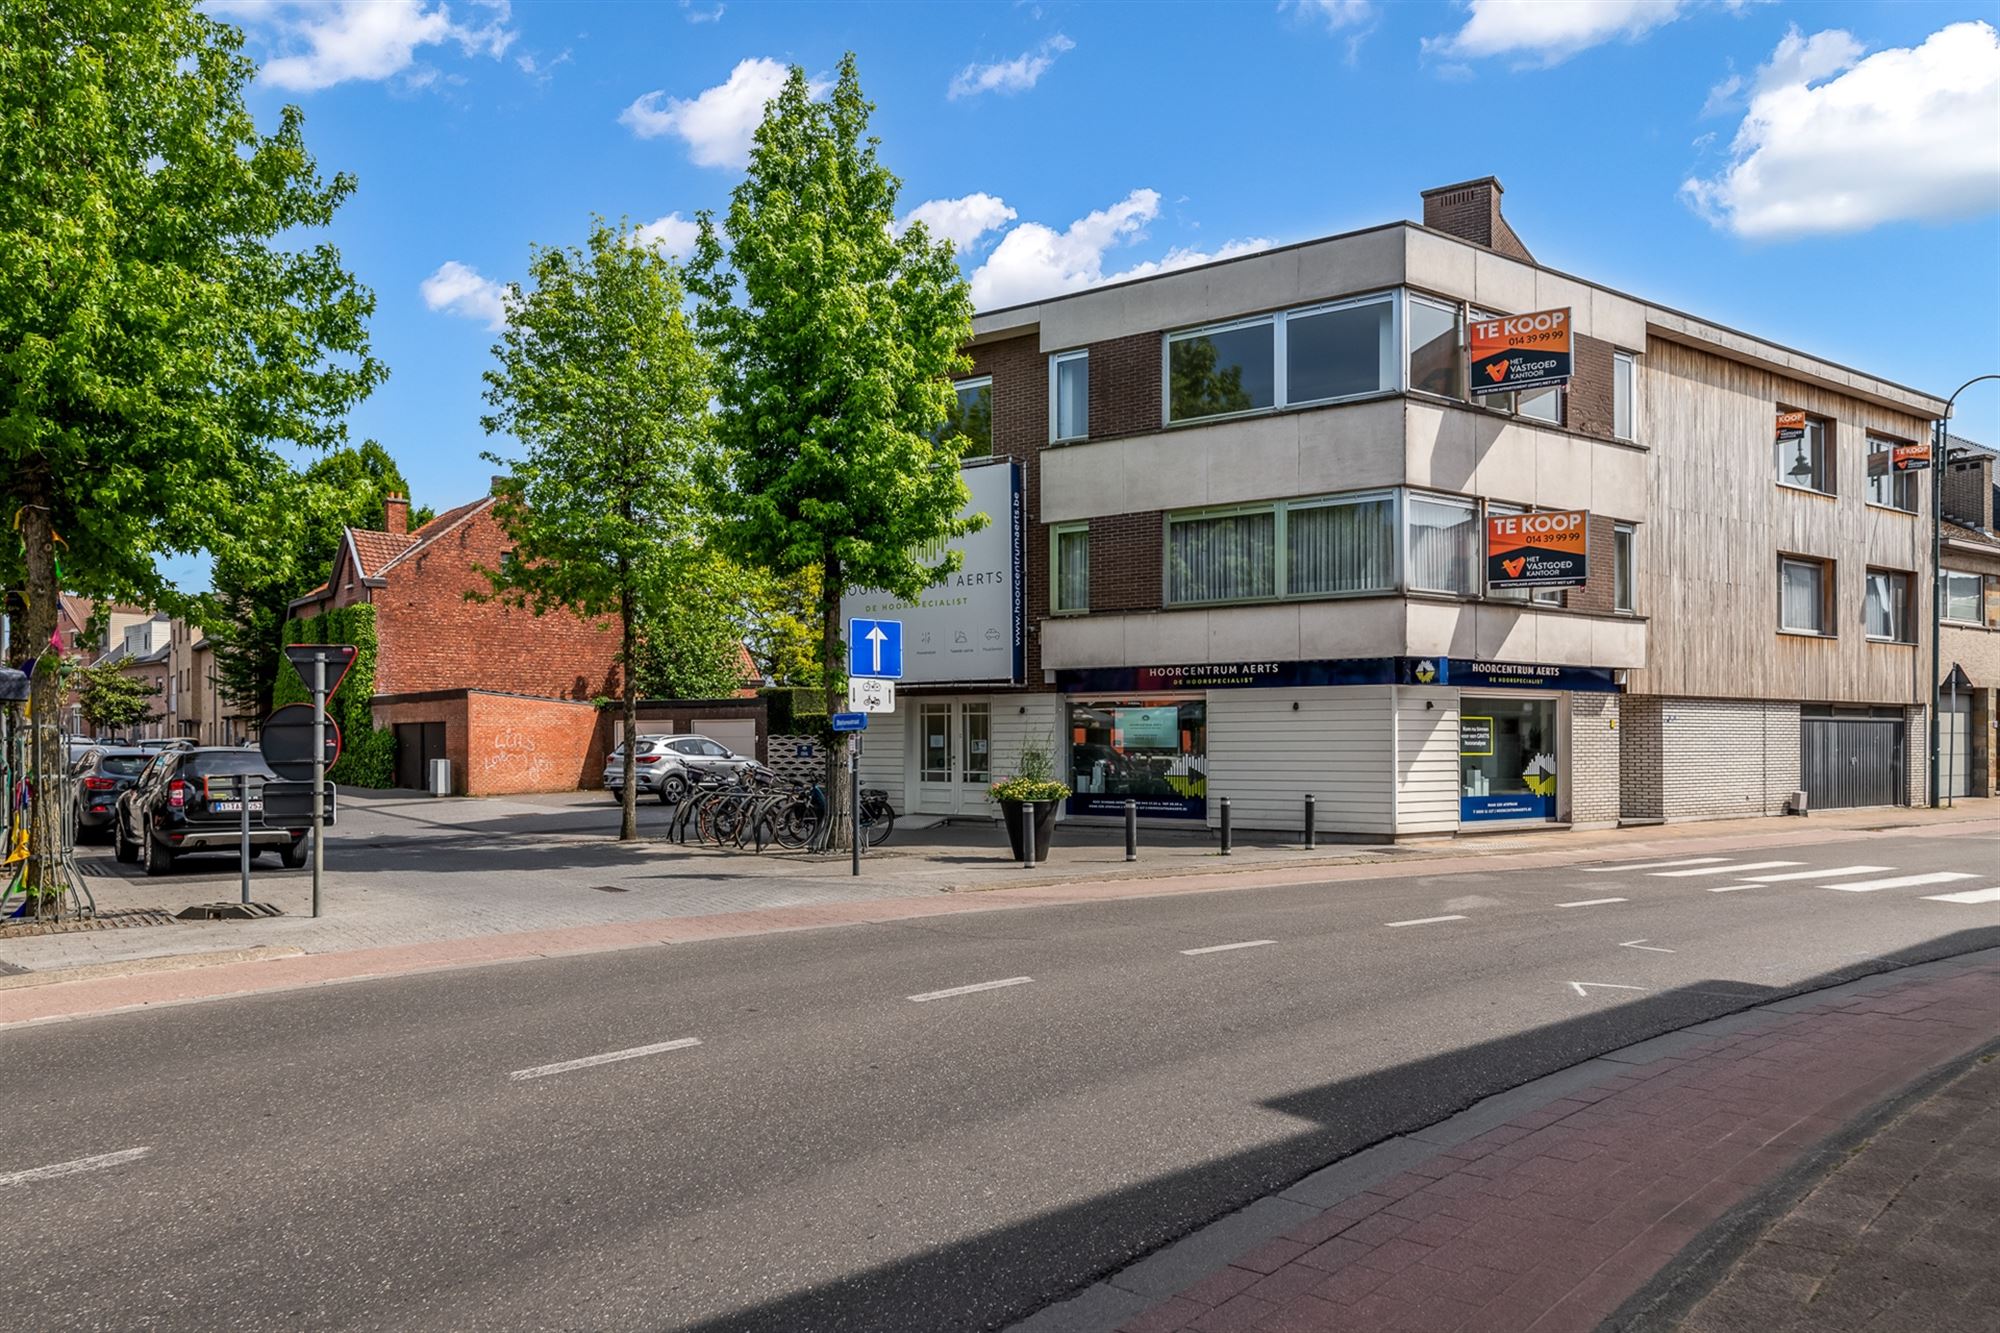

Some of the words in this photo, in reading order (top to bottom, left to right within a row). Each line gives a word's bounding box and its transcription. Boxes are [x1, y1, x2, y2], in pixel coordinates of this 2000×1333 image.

[1476, 322, 1499, 340] TE
[1504, 312, 1565, 336] KOOP
[1508, 337, 1525, 346] 014
[1526, 334, 1537, 344] 39
[1539, 332, 1550, 342] 99
[1551, 330, 1564, 340] 99
[1510, 359, 1557, 373] VASTGOED
[1510, 369, 1544, 380] KANTOOR
[1778, 414, 1803, 423] KOOP
[1494, 518, 1517, 535] TE
[1521, 514, 1582, 534] KOOP
[1526, 535, 1541, 544] 014
[1543, 534, 1554, 543] 39
[1556, 533, 1567, 542] 99
[1568, 532, 1580, 541] 99
[1013, 491, 1021, 647] www.hoorcentrumaerts.be
[1526, 560, 1573, 570] VASTGOED
[956, 571, 1003, 587] AERTS
[1526, 569, 1560, 577] KANTOOR
[865, 604, 877, 613] DE
[1150, 665, 1238, 677] HOORCENTRUM
[1242, 664, 1279, 675] AERTS
[1472, 663, 1534, 675] HOORCENTRUM
[1536, 666, 1560, 676] AERTS
[1186, 677, 1254, 685] HOORSPECIALIST
